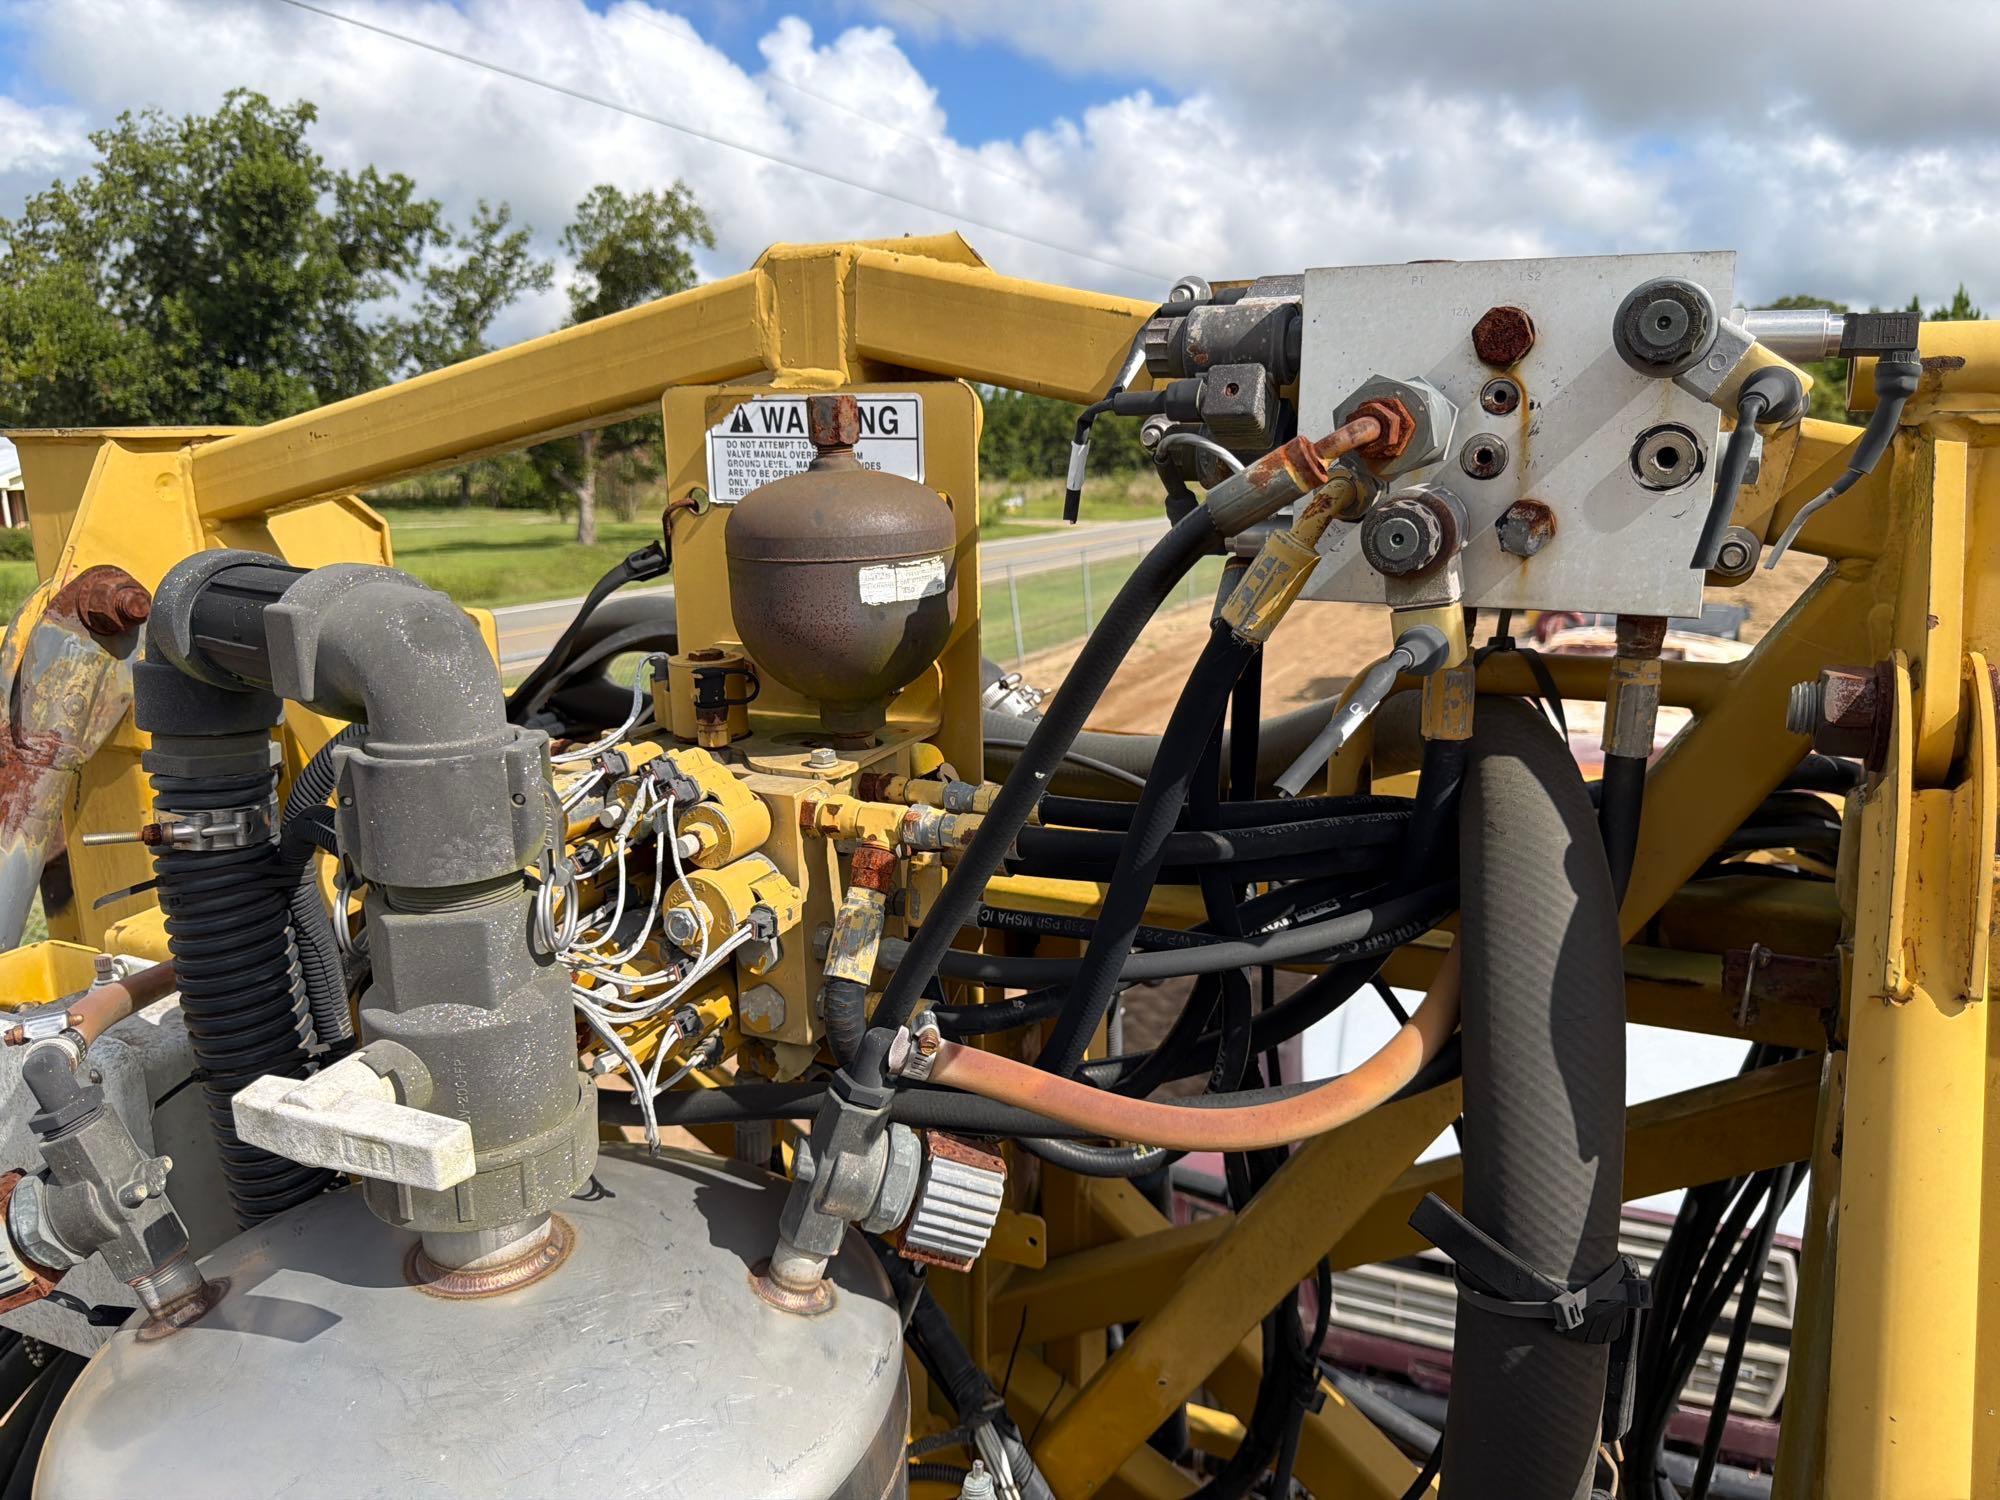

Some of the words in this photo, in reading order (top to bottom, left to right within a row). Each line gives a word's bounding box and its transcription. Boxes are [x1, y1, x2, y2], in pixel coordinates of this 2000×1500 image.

[760, 406, 899, 435] WANG
[727, 440, 738, 449] DO
[740, 440, 756, 449] NOT
[758, 441, 795, 450] ATTEMPT
[797, 441, 809, 450] TO
[726, 450, 751, 459] VALVE
[753, 450, 787, 460] MANUAL
[727, 459, 761, 469] GROUND
[763, 460, 792, 469] LEVEL.
[728, 469, 744, 478] ARE
[746, 469, 757, 478] TO
[759, 469, 771, 478] BE
[728, 478, 752, 488] ONLY.
[980, 908, 994, 922] IC
[998, 912, 1033, 928] MSHA
